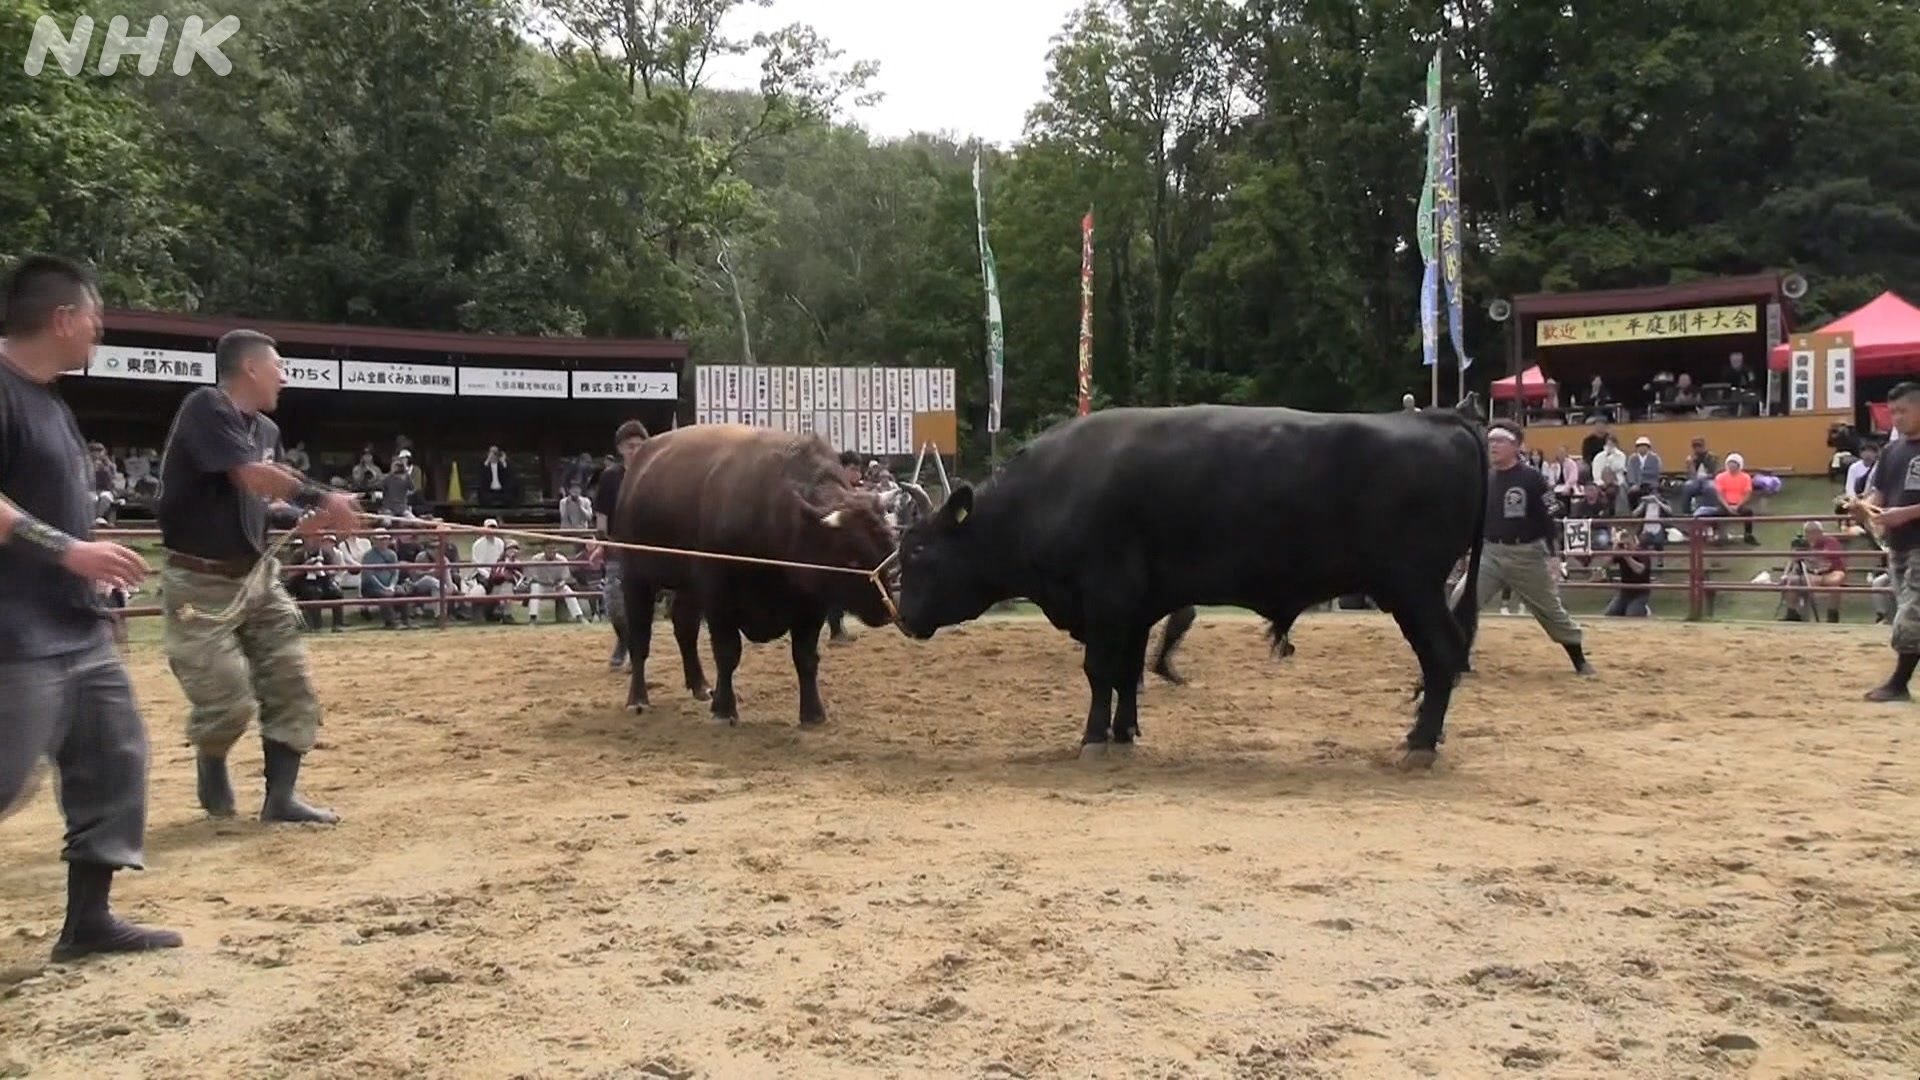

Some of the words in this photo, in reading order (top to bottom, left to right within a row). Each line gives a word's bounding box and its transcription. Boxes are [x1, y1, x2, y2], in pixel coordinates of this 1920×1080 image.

[127, 357, 203, 377] 東急不動産
[1566, 522, 1588, 552] 西
